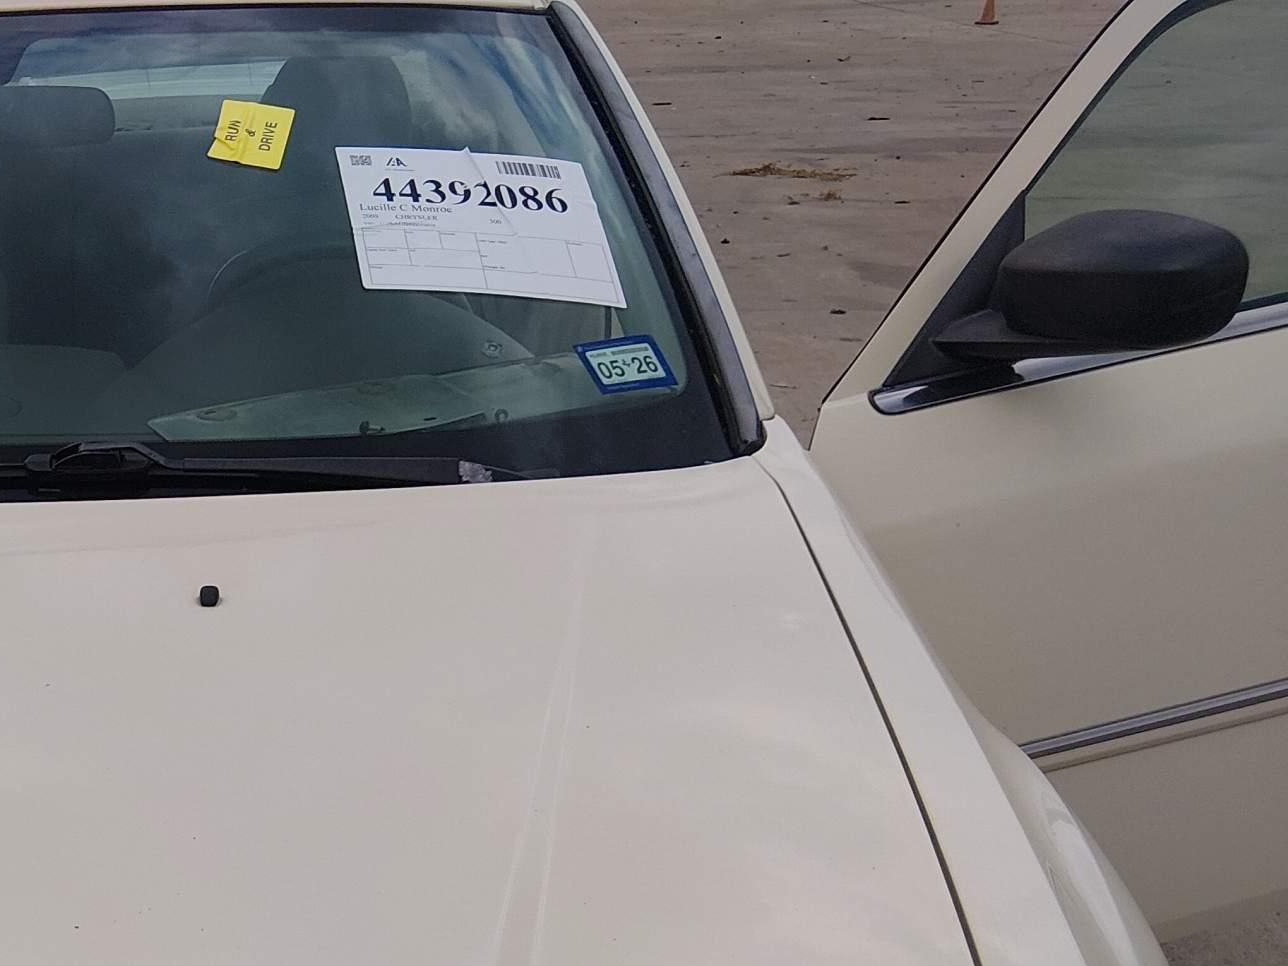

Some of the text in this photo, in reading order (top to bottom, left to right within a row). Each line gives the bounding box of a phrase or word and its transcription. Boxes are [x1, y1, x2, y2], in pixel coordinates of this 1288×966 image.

[225, 120, 241, 141] RUN
[258, 121, 278, 151] DRIVE
[360, 203, 454, 213] Lucille C Monroe
[373, 177, 568, 214] 44392086
[597, 355, 659, 380] 05 26
